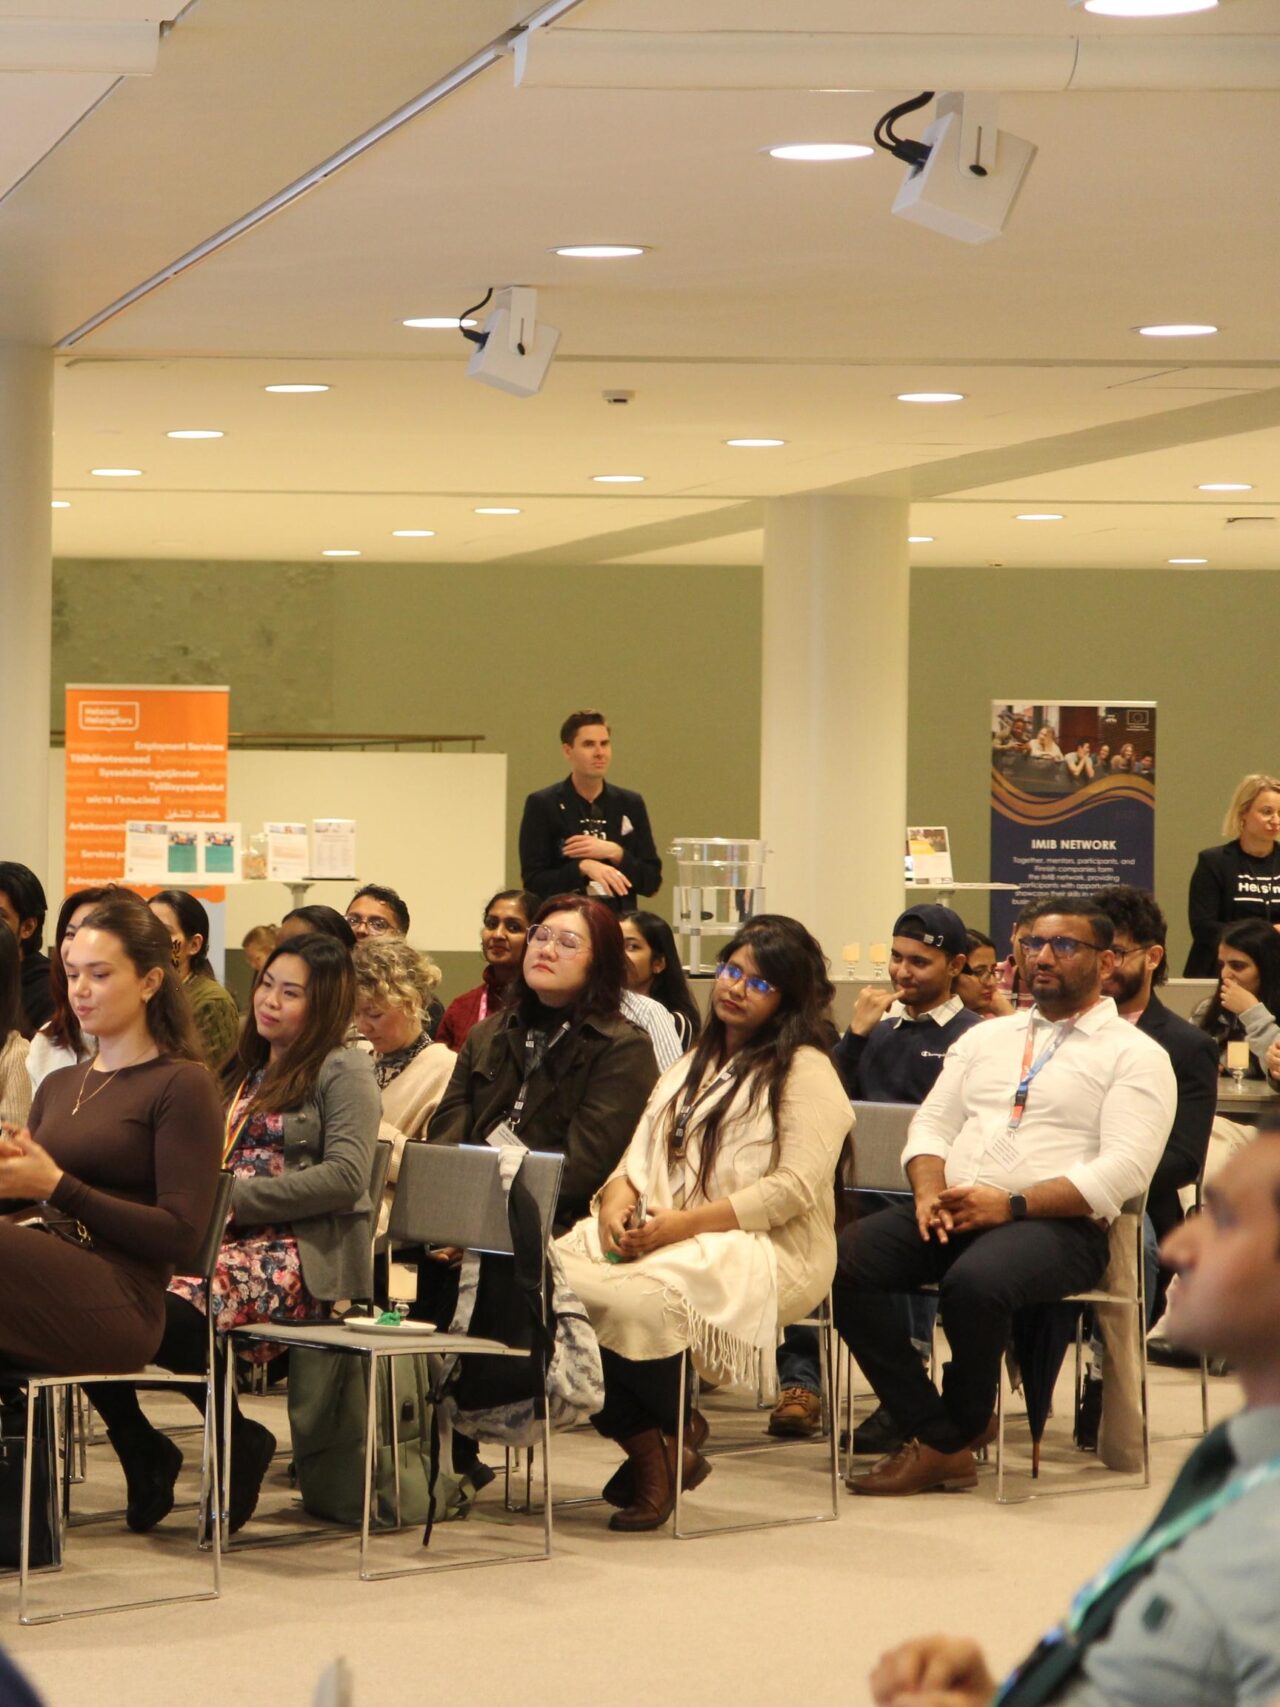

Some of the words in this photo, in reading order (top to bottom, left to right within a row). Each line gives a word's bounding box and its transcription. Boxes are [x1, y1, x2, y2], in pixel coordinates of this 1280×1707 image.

[134, 741, 186, 752] Employment
[187, 742, 225, 751] Services
[1031, 839, 1057, 850] IMIB
[1060, 839, 1117, 850] NETWORK
